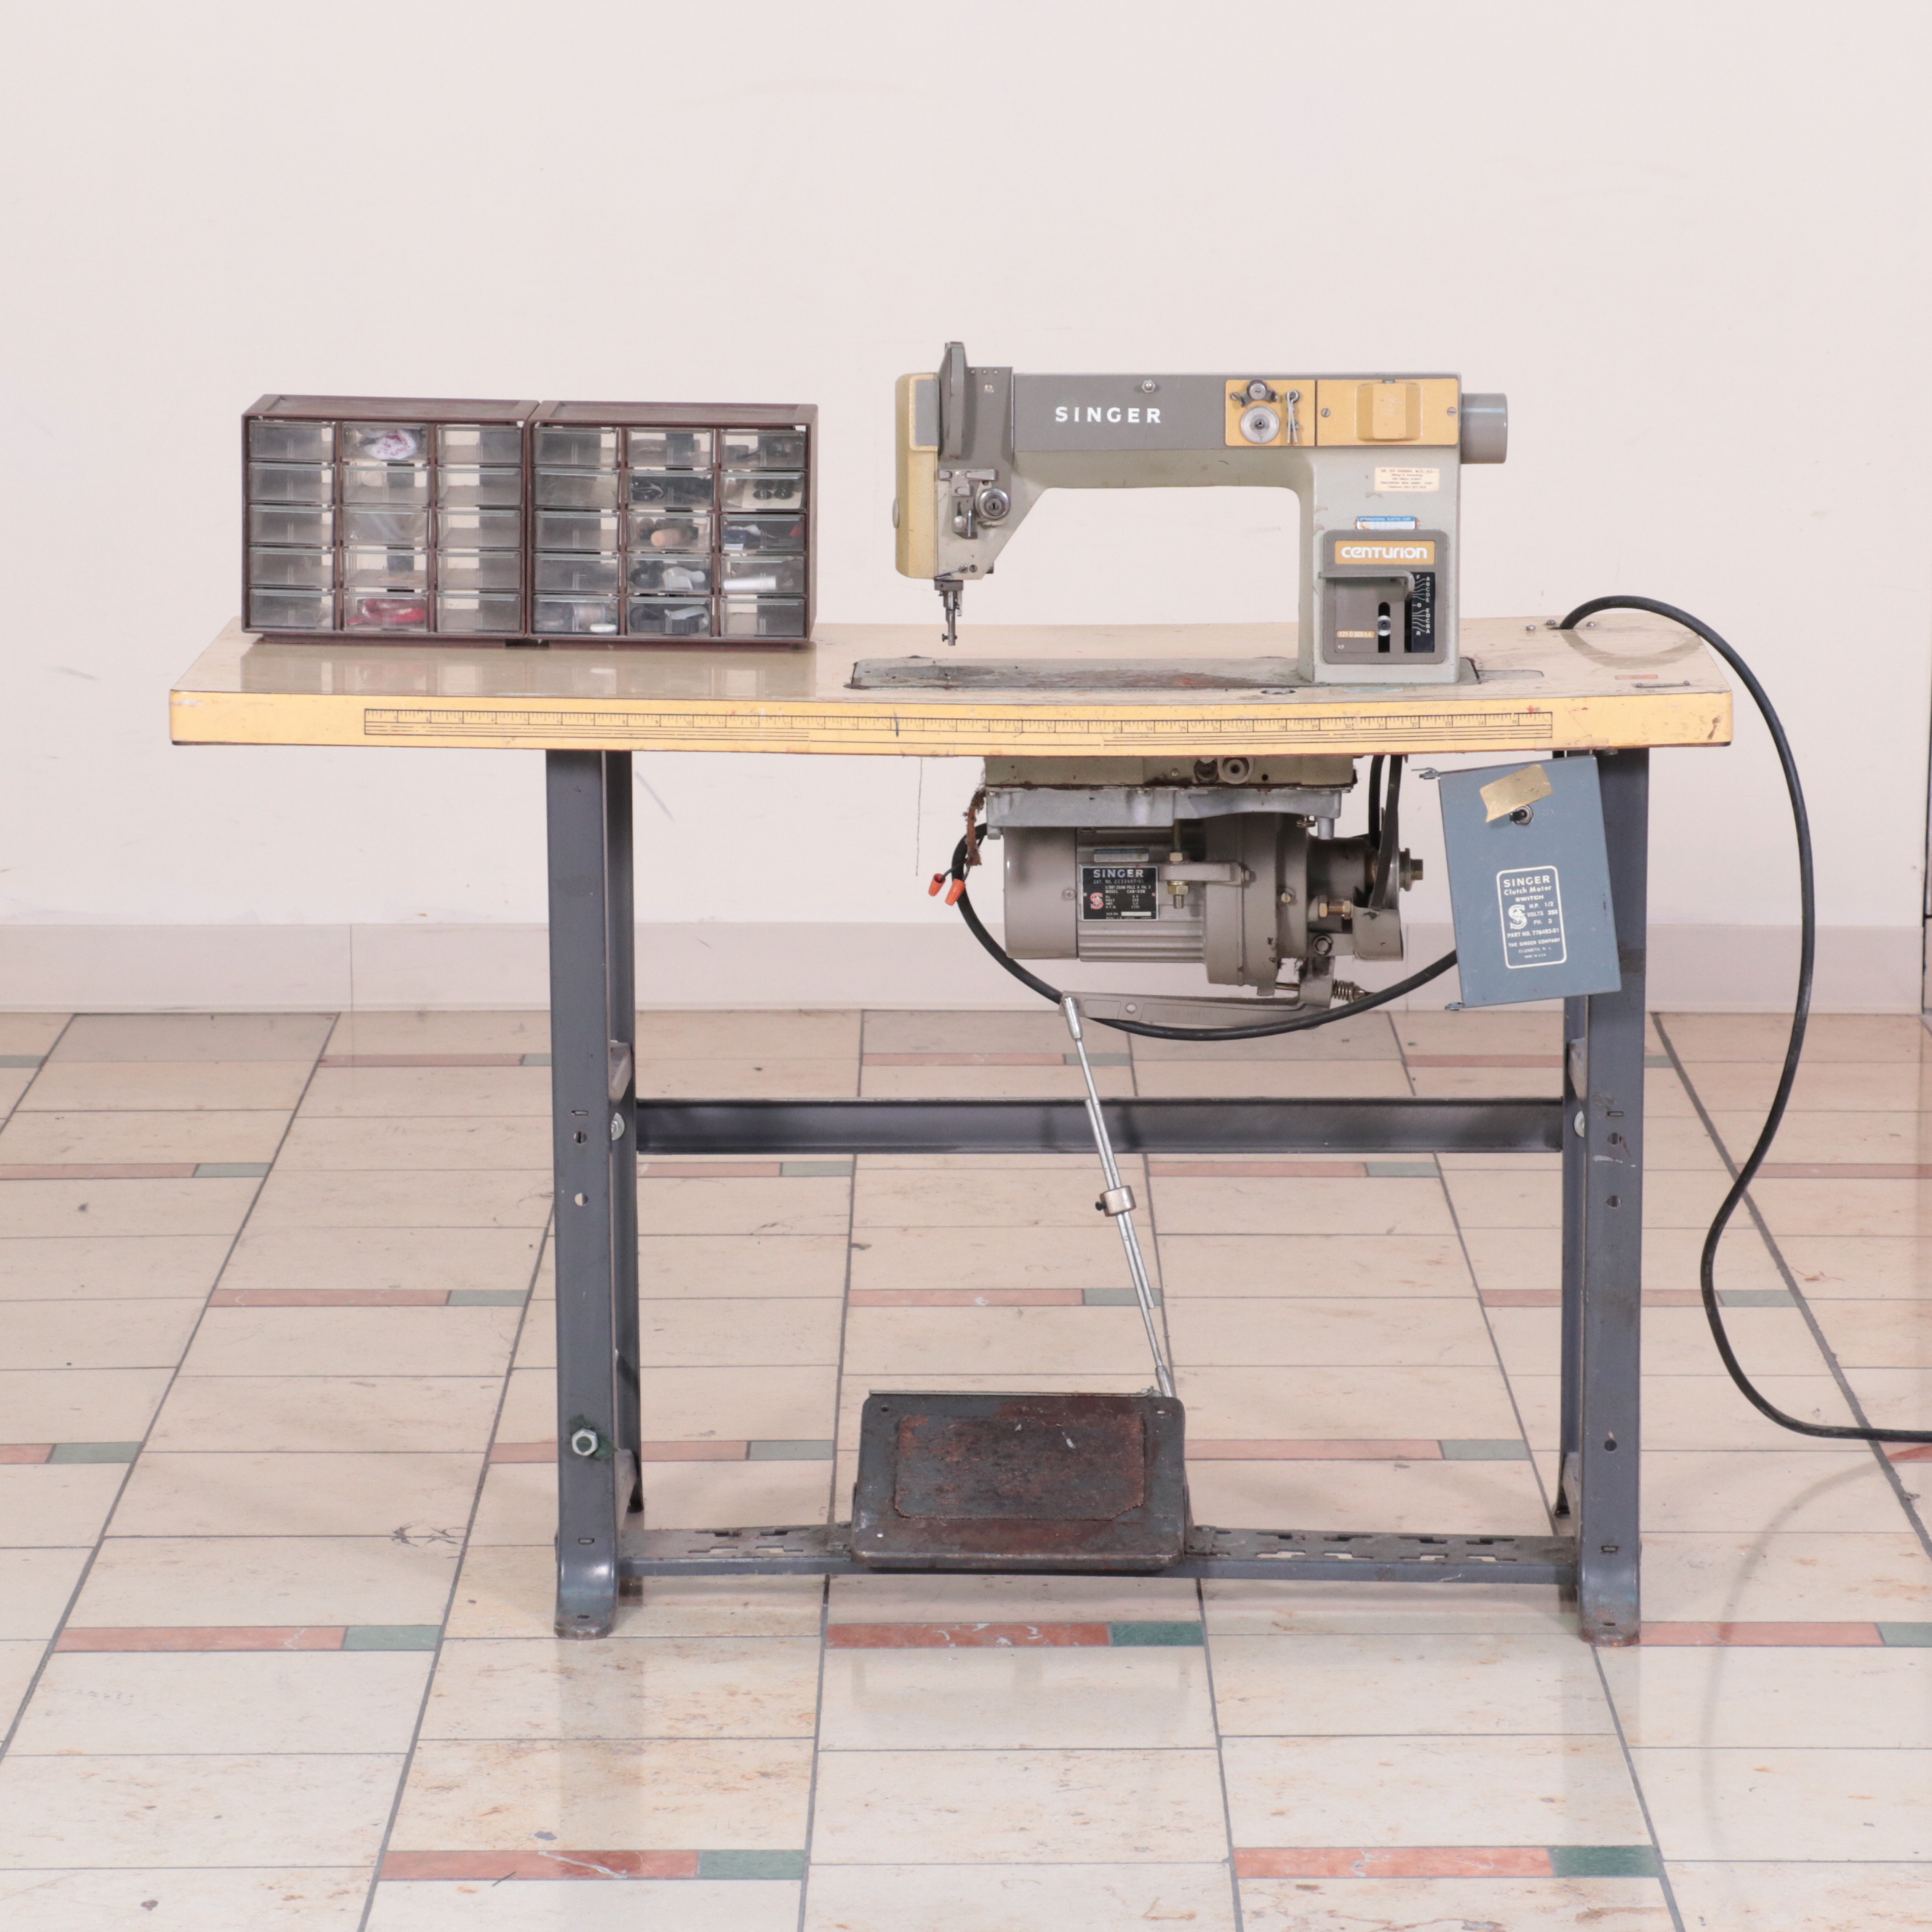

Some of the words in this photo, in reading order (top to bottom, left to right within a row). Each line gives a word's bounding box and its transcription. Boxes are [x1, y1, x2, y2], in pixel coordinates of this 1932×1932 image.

[1055, 407, 1161, 423] SINGER
[1093, 869, 1143, 878] SINGER
[1504, 875, 1551, 887] SINGER
[1504, 887, 1528, 895] Clutch
[1530, 885, 1552, 893] Motor
